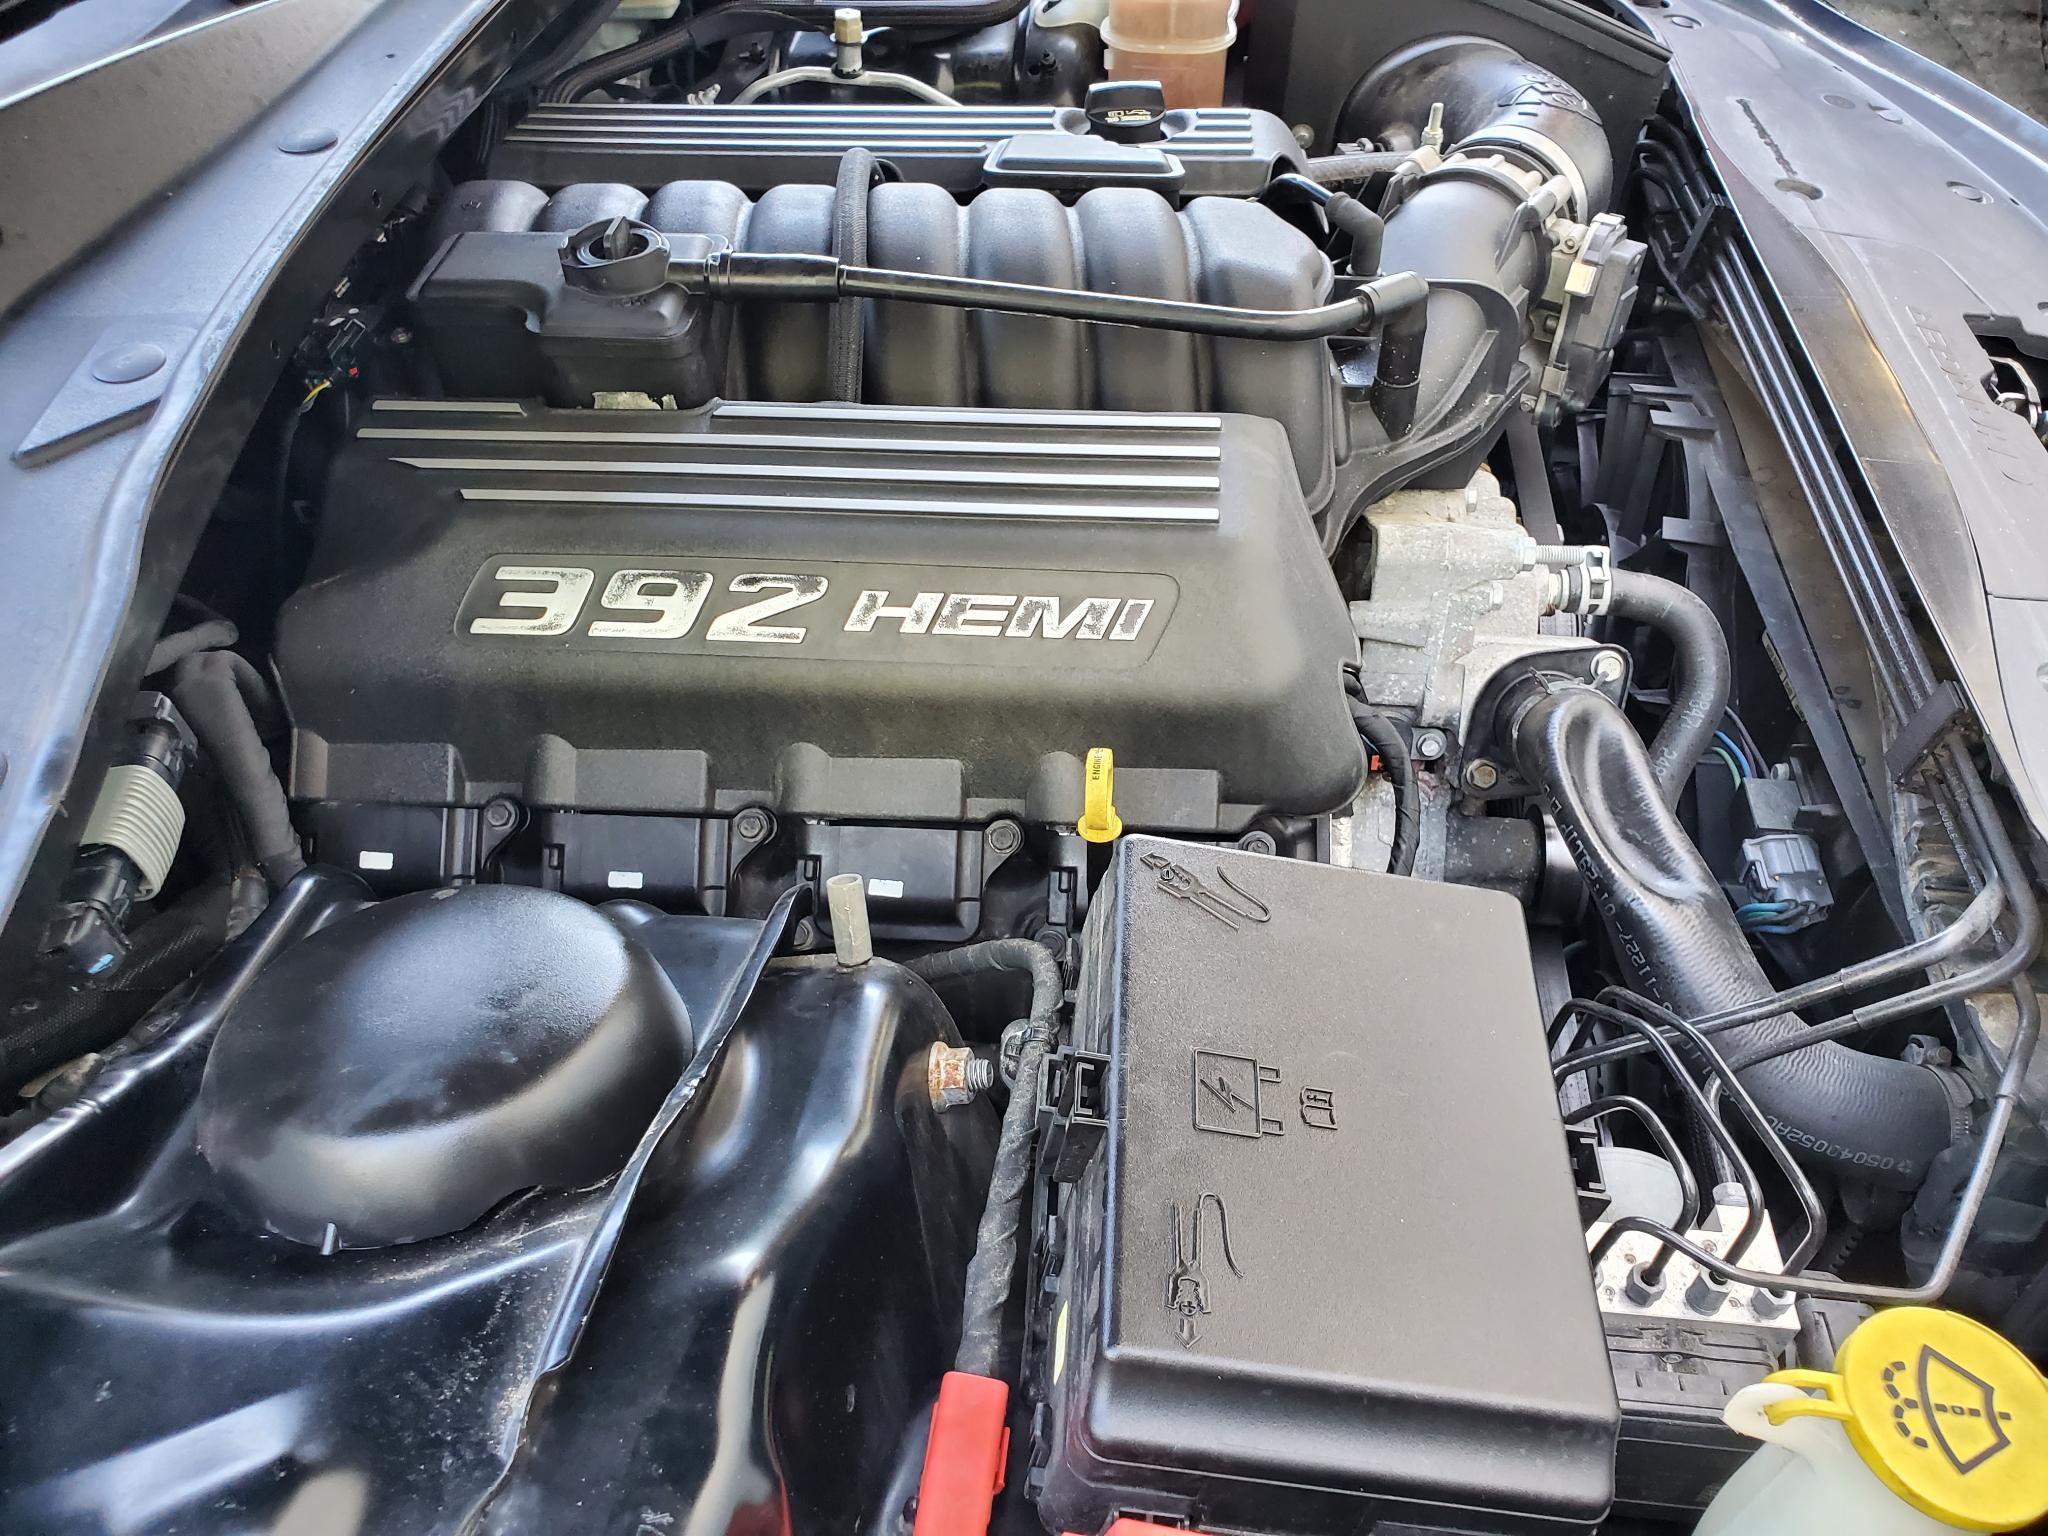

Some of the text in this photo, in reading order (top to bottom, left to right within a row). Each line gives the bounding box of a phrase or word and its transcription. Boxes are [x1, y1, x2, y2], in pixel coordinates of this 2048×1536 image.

[469, 565, 1155, 642] 392 HEMI
[1091, 755, 1102, 781] ENGINE
